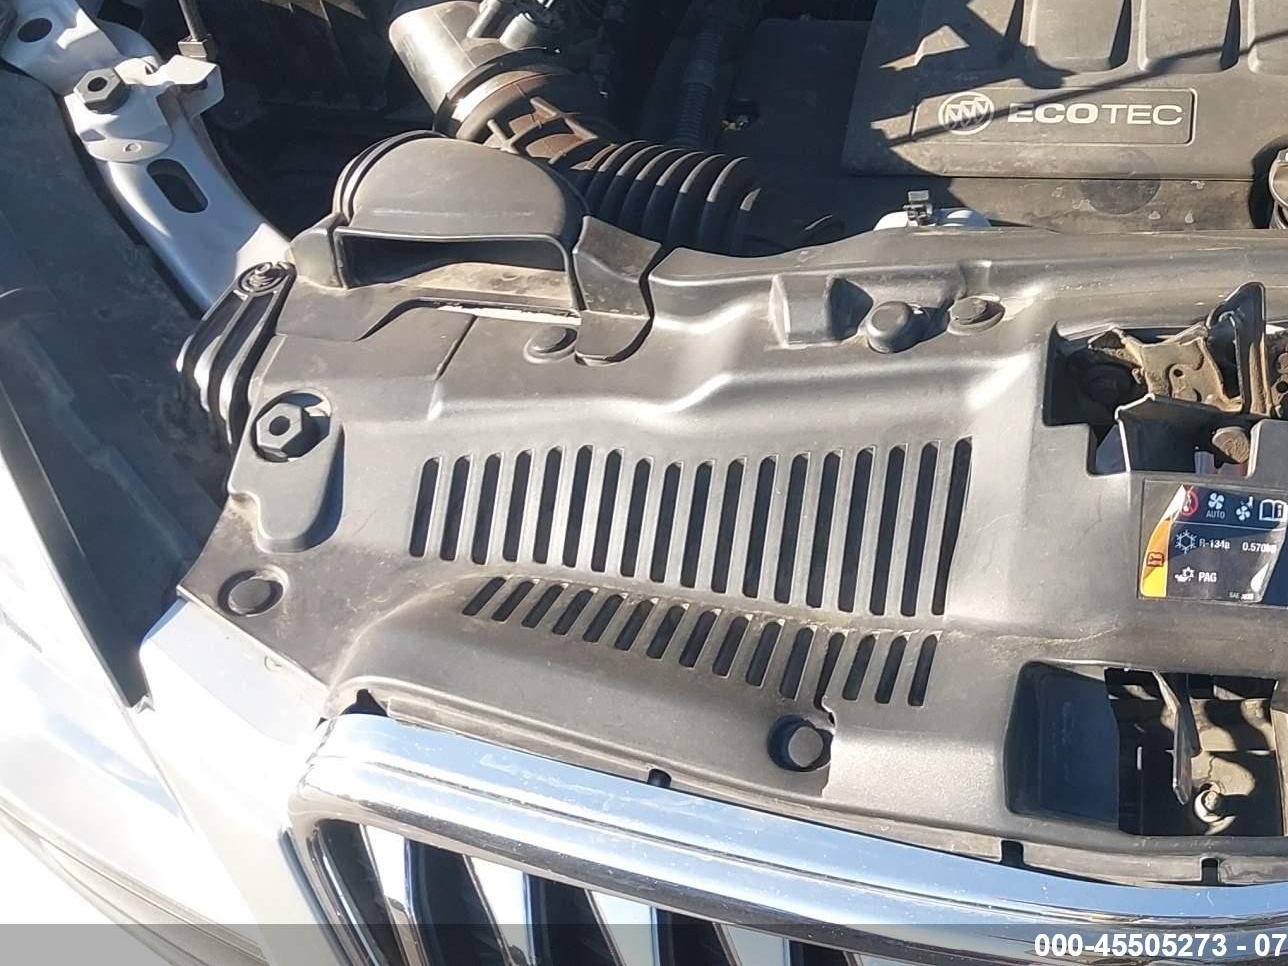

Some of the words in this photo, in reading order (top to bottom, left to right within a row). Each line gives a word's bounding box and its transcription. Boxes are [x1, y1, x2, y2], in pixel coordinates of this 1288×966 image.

[1007, 102, 1184, 126] ECOTEC
[1206, 510, 1226, 520] AUTO
[1199, 538, 1231, 550] R-134a
[1198, 571, 1217, 583] PAG
